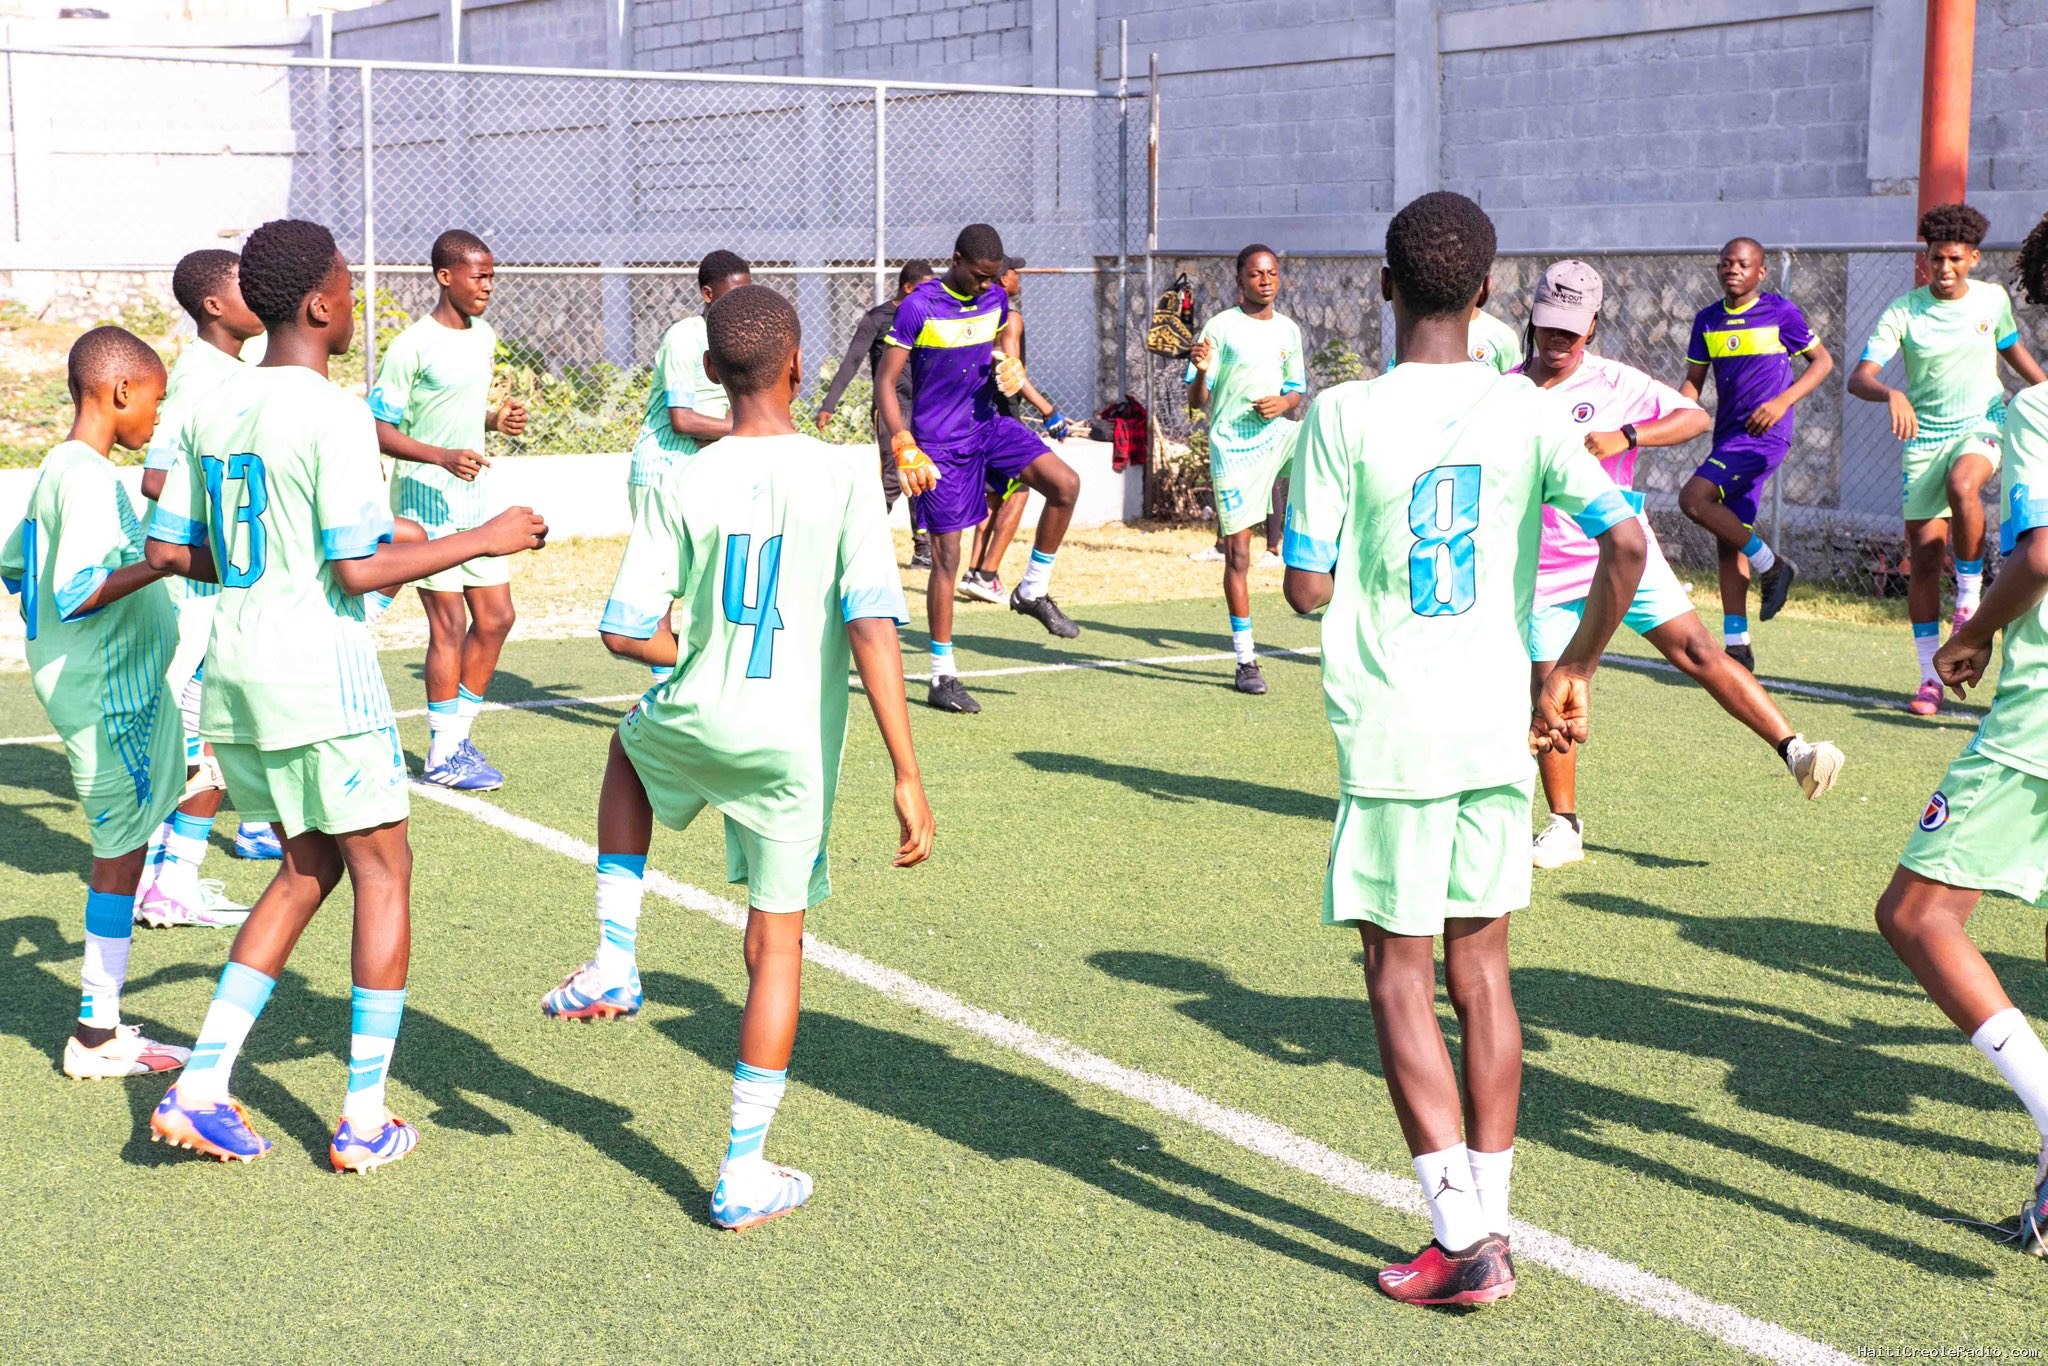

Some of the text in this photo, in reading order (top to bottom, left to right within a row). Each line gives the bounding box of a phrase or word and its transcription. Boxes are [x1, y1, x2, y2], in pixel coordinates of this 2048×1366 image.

[200, 452, 268, 589] 13
[1408, 464, 1481, 617] 8
[722, 534, 785, 679] 4
